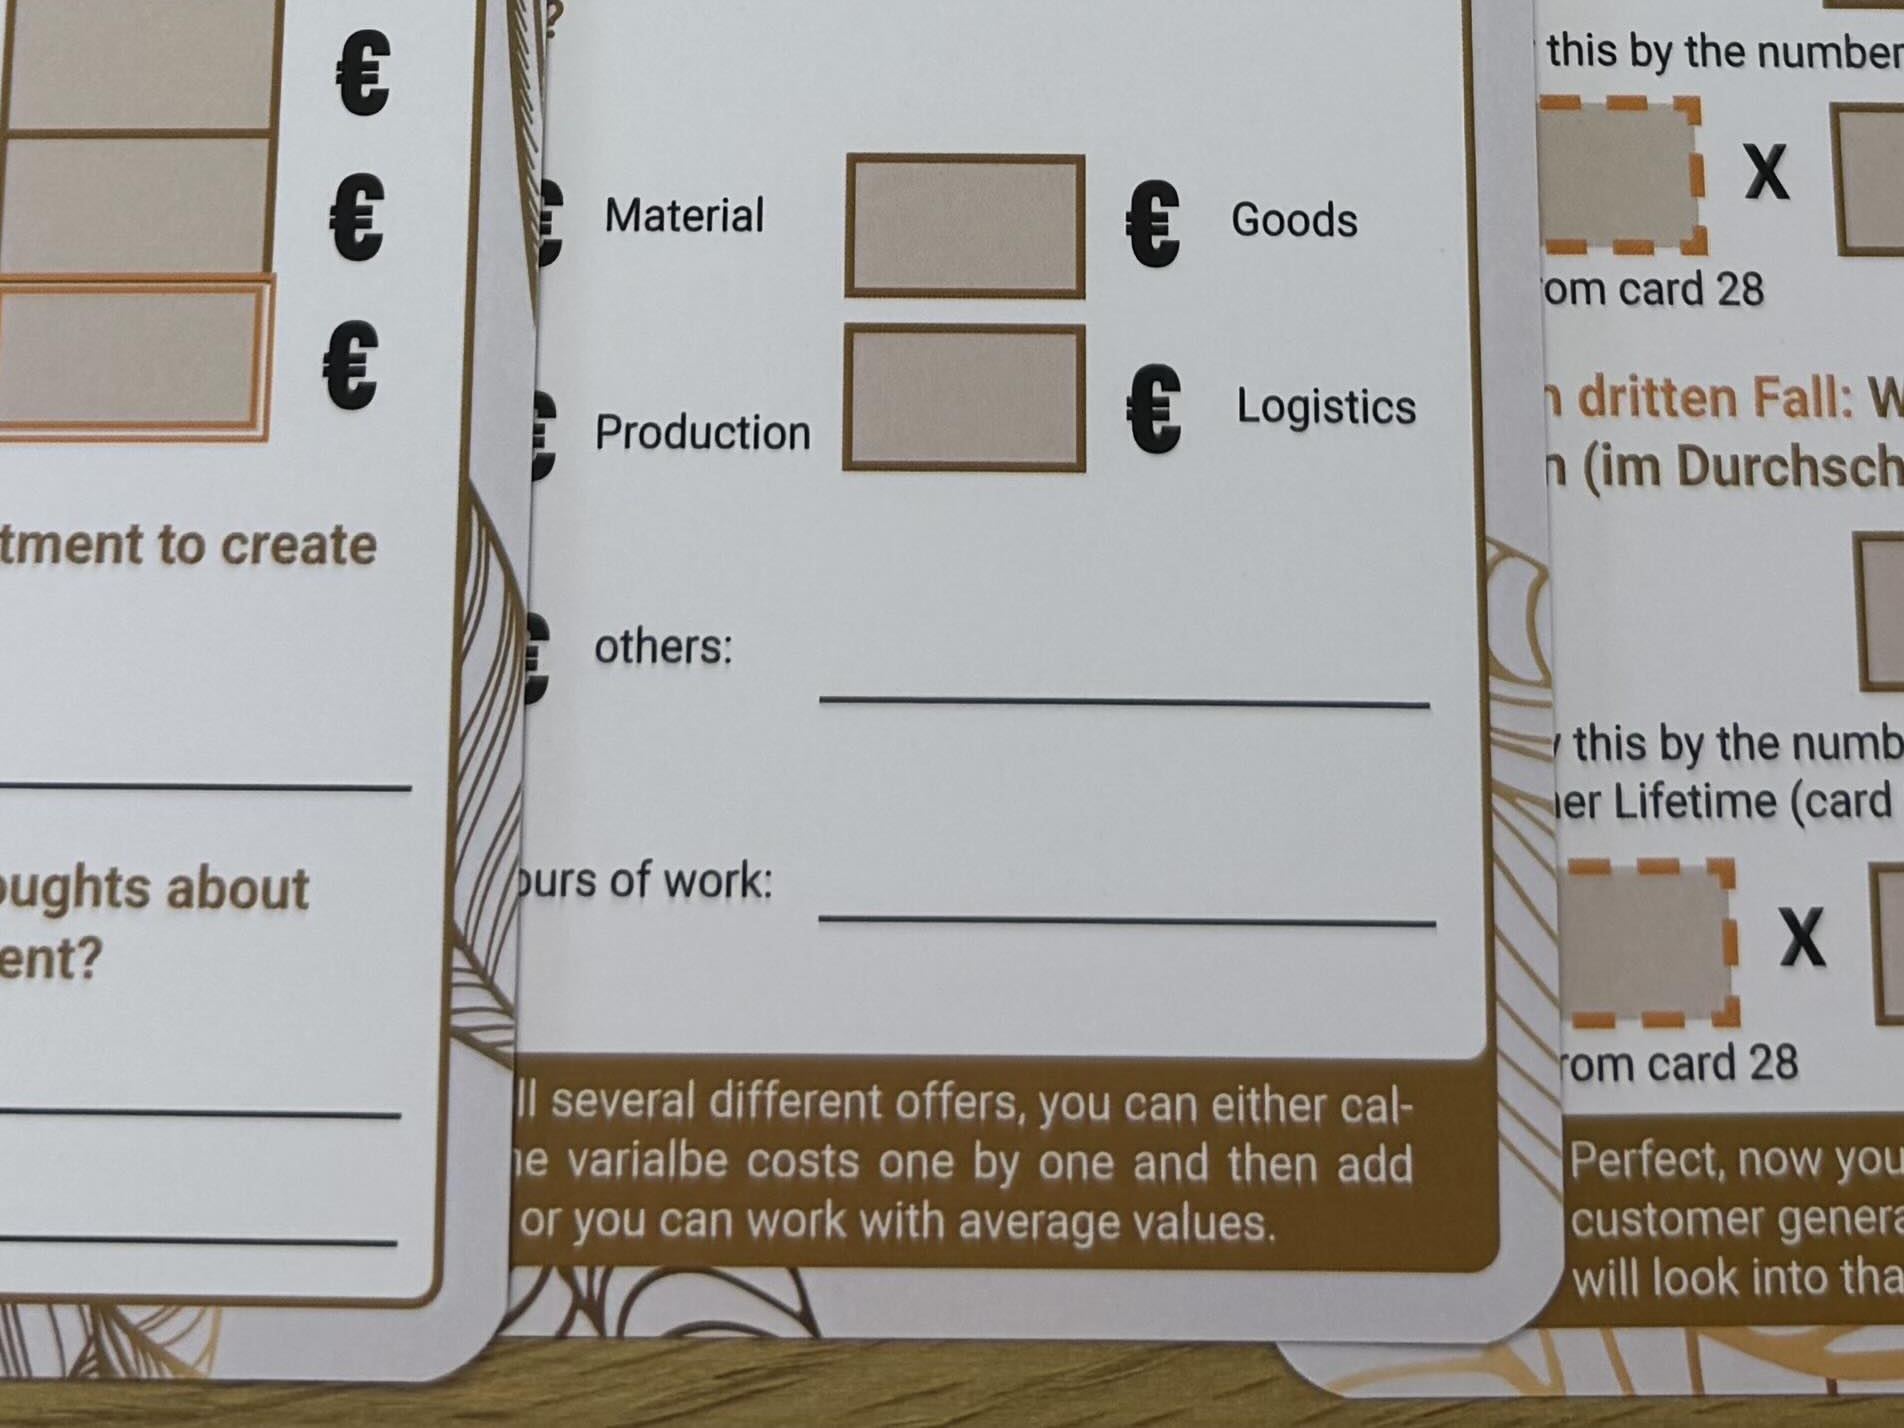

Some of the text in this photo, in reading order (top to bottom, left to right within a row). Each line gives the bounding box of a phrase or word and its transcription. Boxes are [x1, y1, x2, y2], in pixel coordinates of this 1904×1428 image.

[606, 195, 764, 233] Material
[1232, 200, 1358, 238] Goods
[1238, 386, 1417, 433] Logistics
[1578, 372, 1737, 418] dritten
[1754, 373, 1853, 419] Fall:
[596, 411, 810, 451] Production
[595, 624, 733, 665] others:
[520, 1197, 1277, 1250] or you can work with average values.
[1572, 1256, 1639, 1298] will
[1653, 1255, 1740, 1297] look
[1753, 1260, 1829, 1296] into
